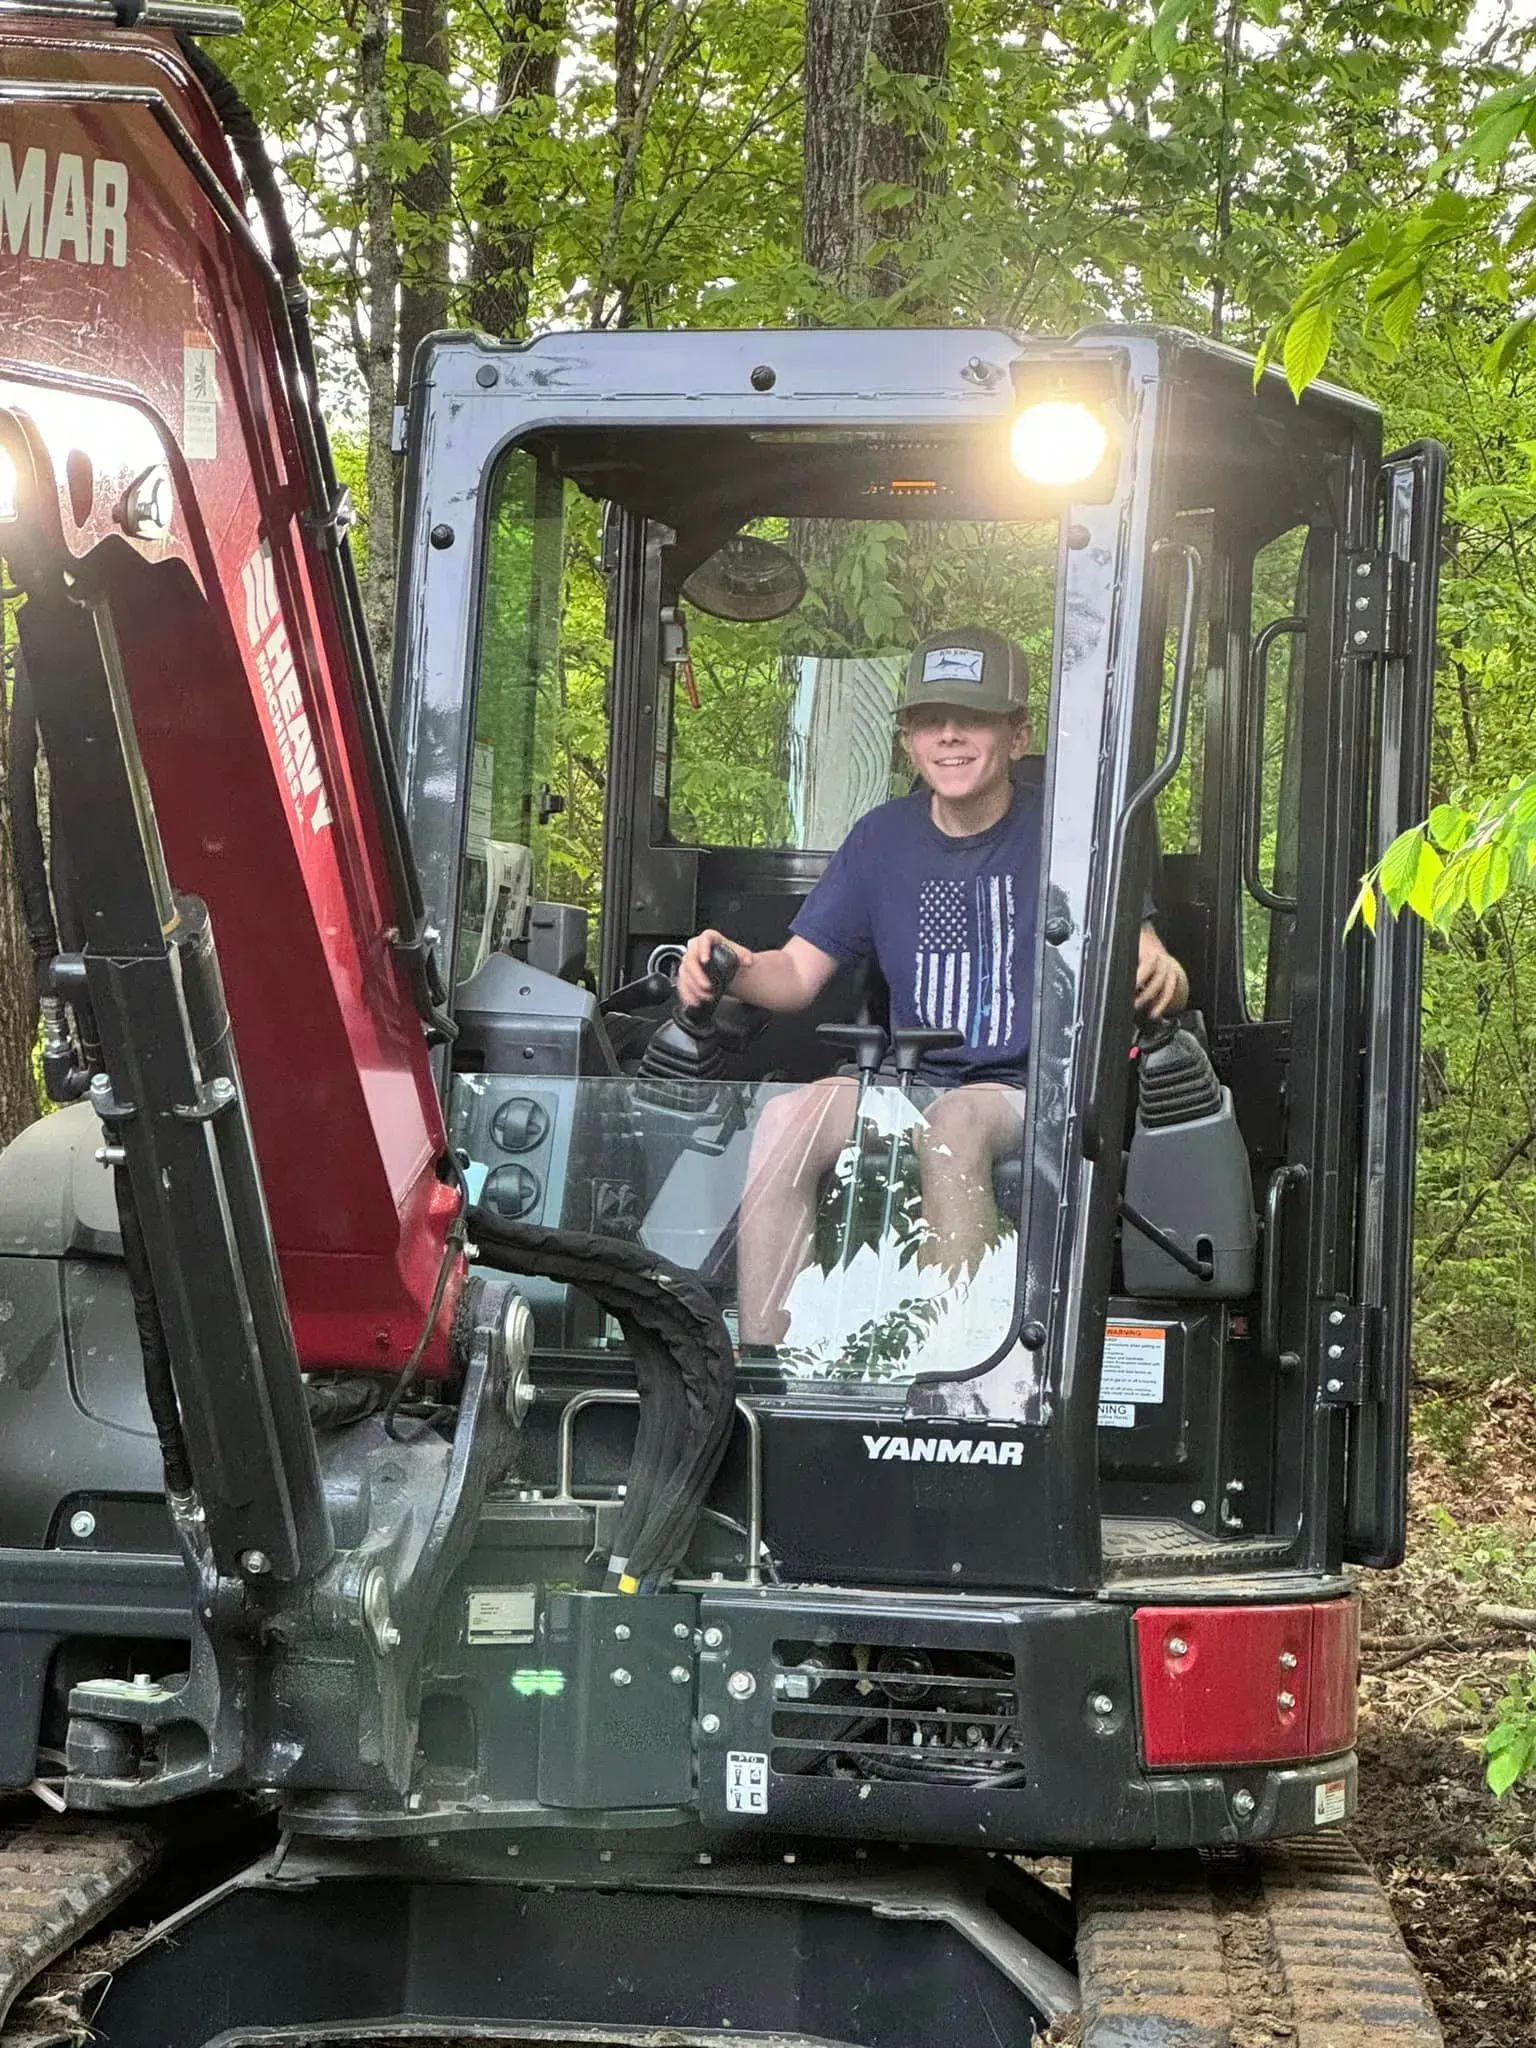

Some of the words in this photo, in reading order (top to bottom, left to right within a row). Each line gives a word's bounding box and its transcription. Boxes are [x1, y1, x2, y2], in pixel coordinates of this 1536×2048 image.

[0, 142, 129, 268] MAR
[255, 649, 303, 802] MACHINES
[265, 618, 333, 835] HEAVY
[862, 1435, 1025, 1466] YANMAR
